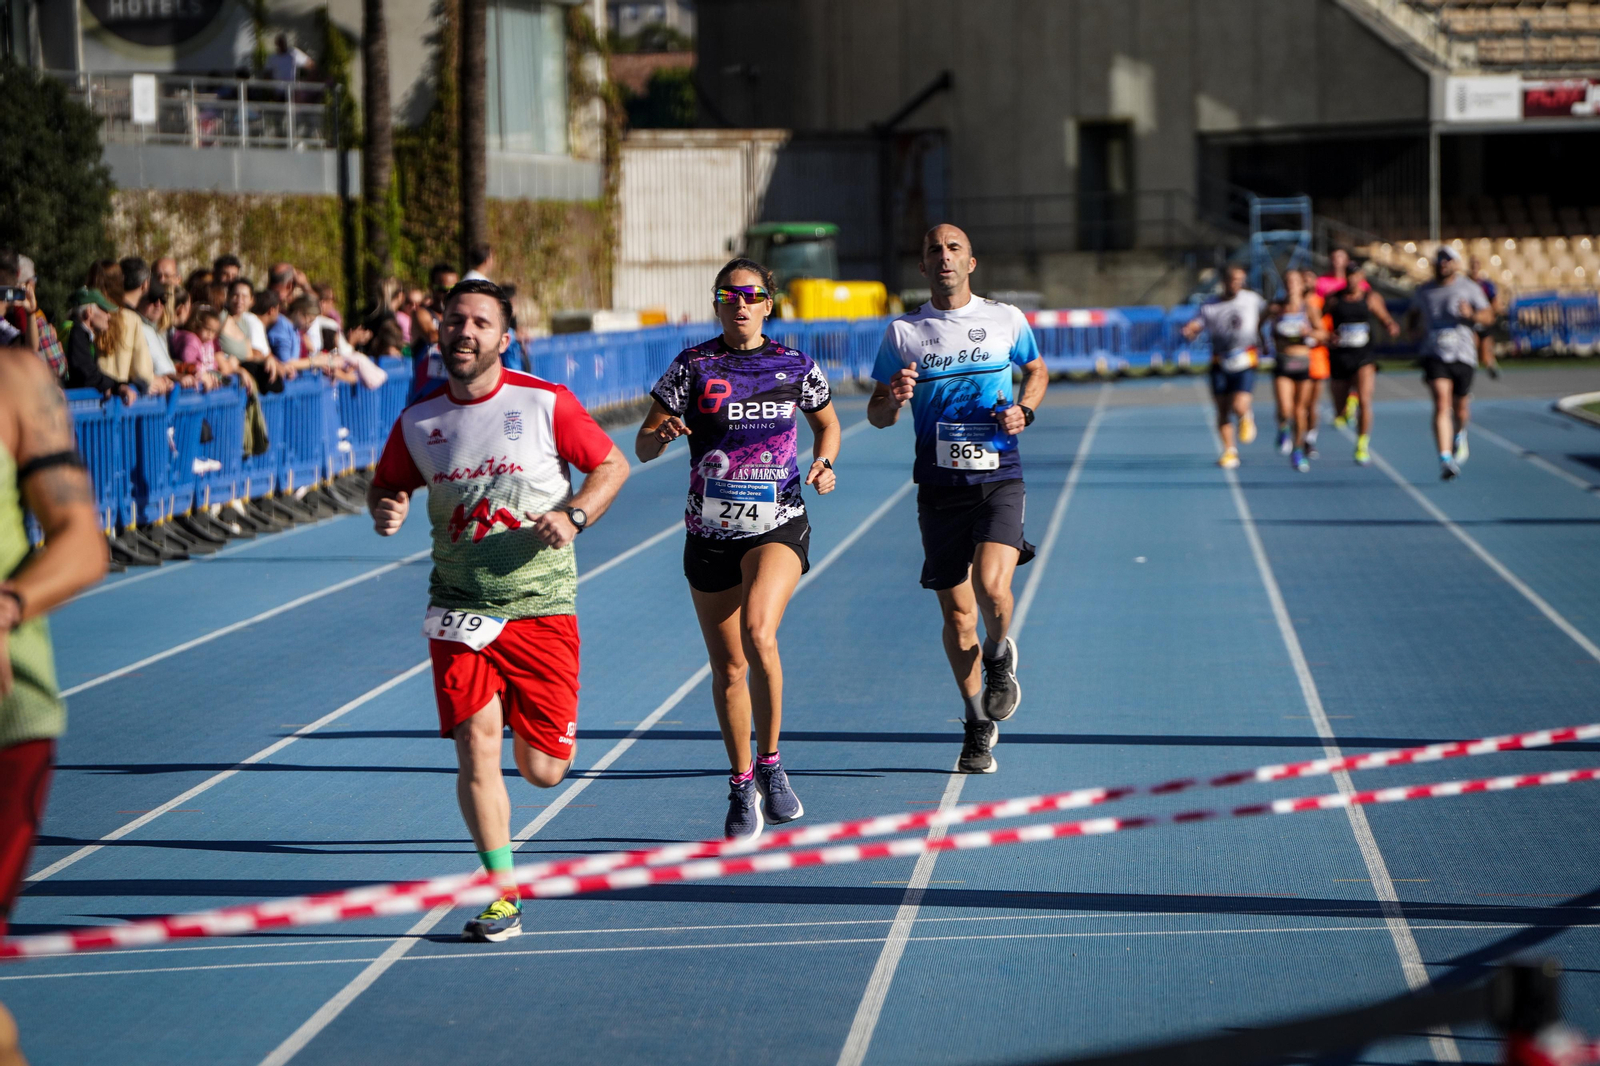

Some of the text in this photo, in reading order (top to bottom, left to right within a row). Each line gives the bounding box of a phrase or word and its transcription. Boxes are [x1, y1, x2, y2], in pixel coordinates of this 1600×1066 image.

[920, 347, 991, 371] Stop & Go
[728, 401, 778, 420] B2B
[728, 423, 776, 431] RUNNING
[950, 443, 983, 459] 865
[432, 456, 523, 484] maratón
[732, 468, 749, 480] LAS
[719, 501, 759, 521] 274
[441, 609, 483, 631] 619
